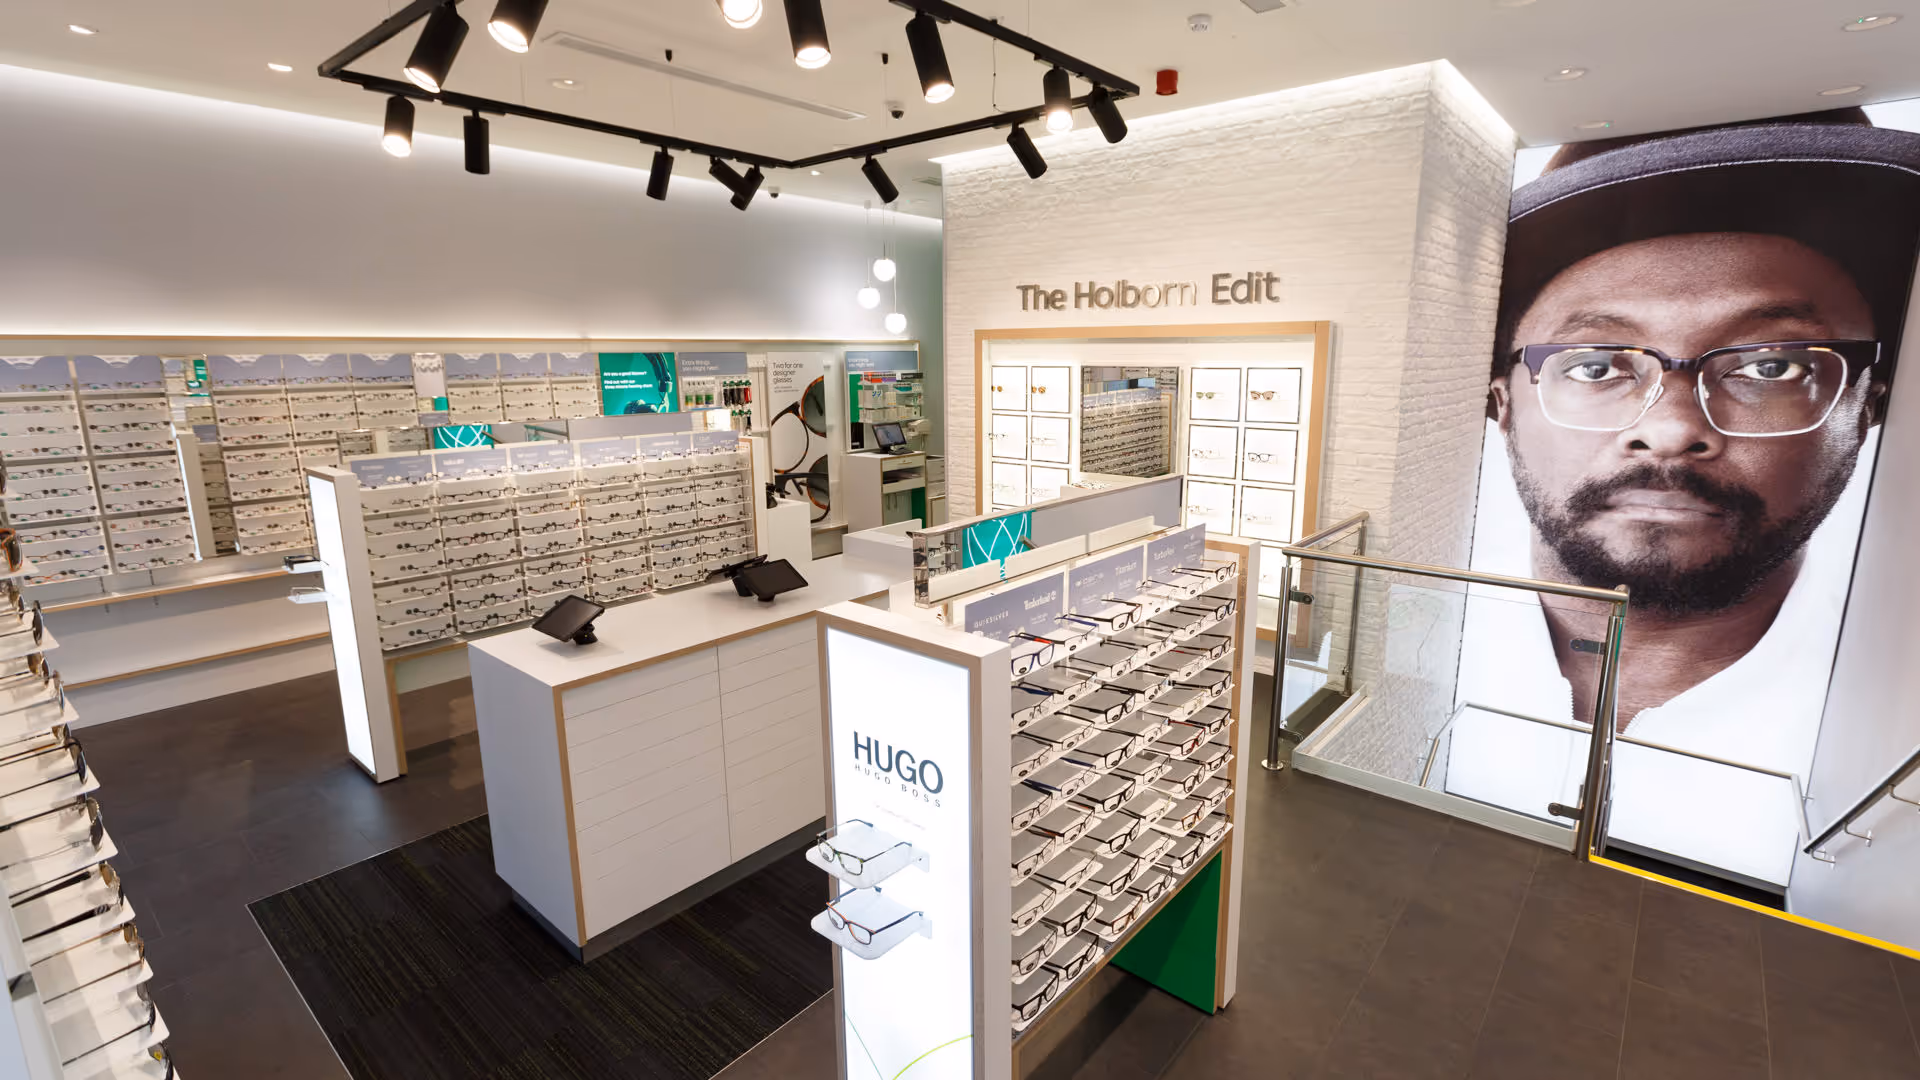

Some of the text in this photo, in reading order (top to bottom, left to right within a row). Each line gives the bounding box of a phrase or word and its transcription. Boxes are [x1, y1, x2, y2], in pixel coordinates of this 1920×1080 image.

[1016, 271, 1281, 311] The Holborn Edit
[773, 370, 797, 378] designer
[773, 377, 793, 385] glasses
[853, 730, 944, 795] HUGO
[854, 763, 941, 808] HUGO BOSS
